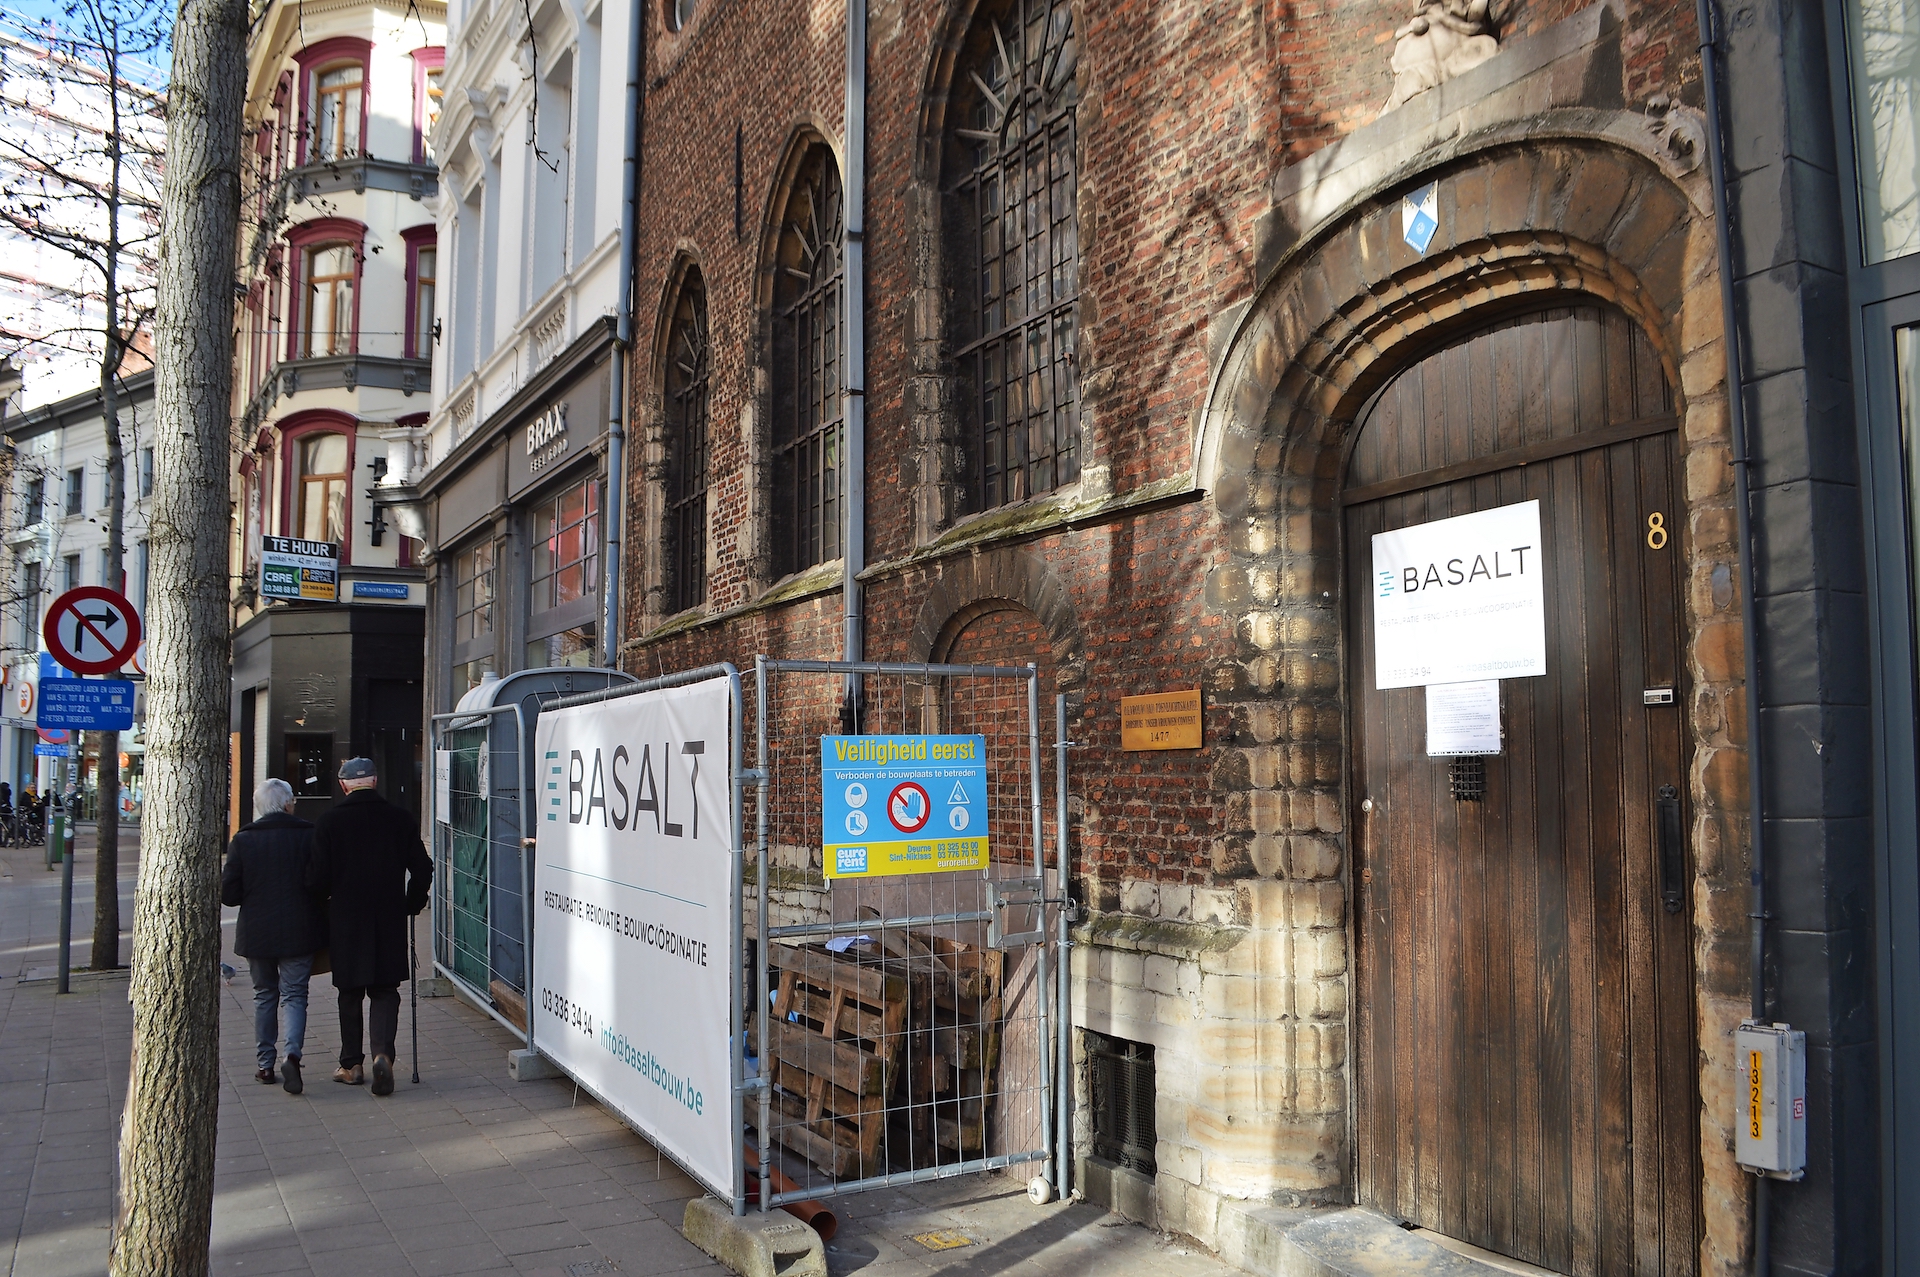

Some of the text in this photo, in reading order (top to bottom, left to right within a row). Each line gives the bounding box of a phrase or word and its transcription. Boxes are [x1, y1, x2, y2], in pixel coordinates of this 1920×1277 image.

[527, 401, 565, 455] BRAX
[530, 438, 568, 473] FEEL GOOD
[1648, 512, 1667, 549] 8
[271, 538, 329, 556] TE HUUR
[265, 572, 292, 583] CBRE
[1404, 546, 1531, 593] BASALT
[1421, 666, 1431, 676] 94
[1151, 732, 1169, 742] 1477
[834, 740, 975, 765] Veiligheid eerst
[835, 771, 874, 780] Verboden
[876, 770, 886, 779] de
[888, 770, 933, 780] bouwplaats
[944, 769, 976, 777] betreden
[569, 740, 704, 839] BASALT
[837, 848, 865, 858] euro
[838, 857, 864, 867] rent
[890, 852, 932, 861] Sint-Niklaas
[937, 858, 978, 868] eurorent.be
[544, 891, 584, 922] RESTAURATIE,
[586, 904, 622, 936] RENOVATIE,
[542, 988, 552, 1012] 03
[554, 994, 568, 1022] 336
[572, 1003, 582, 1030] 34
[601, 1020, 702, 1116] info@basaltbouw.be
